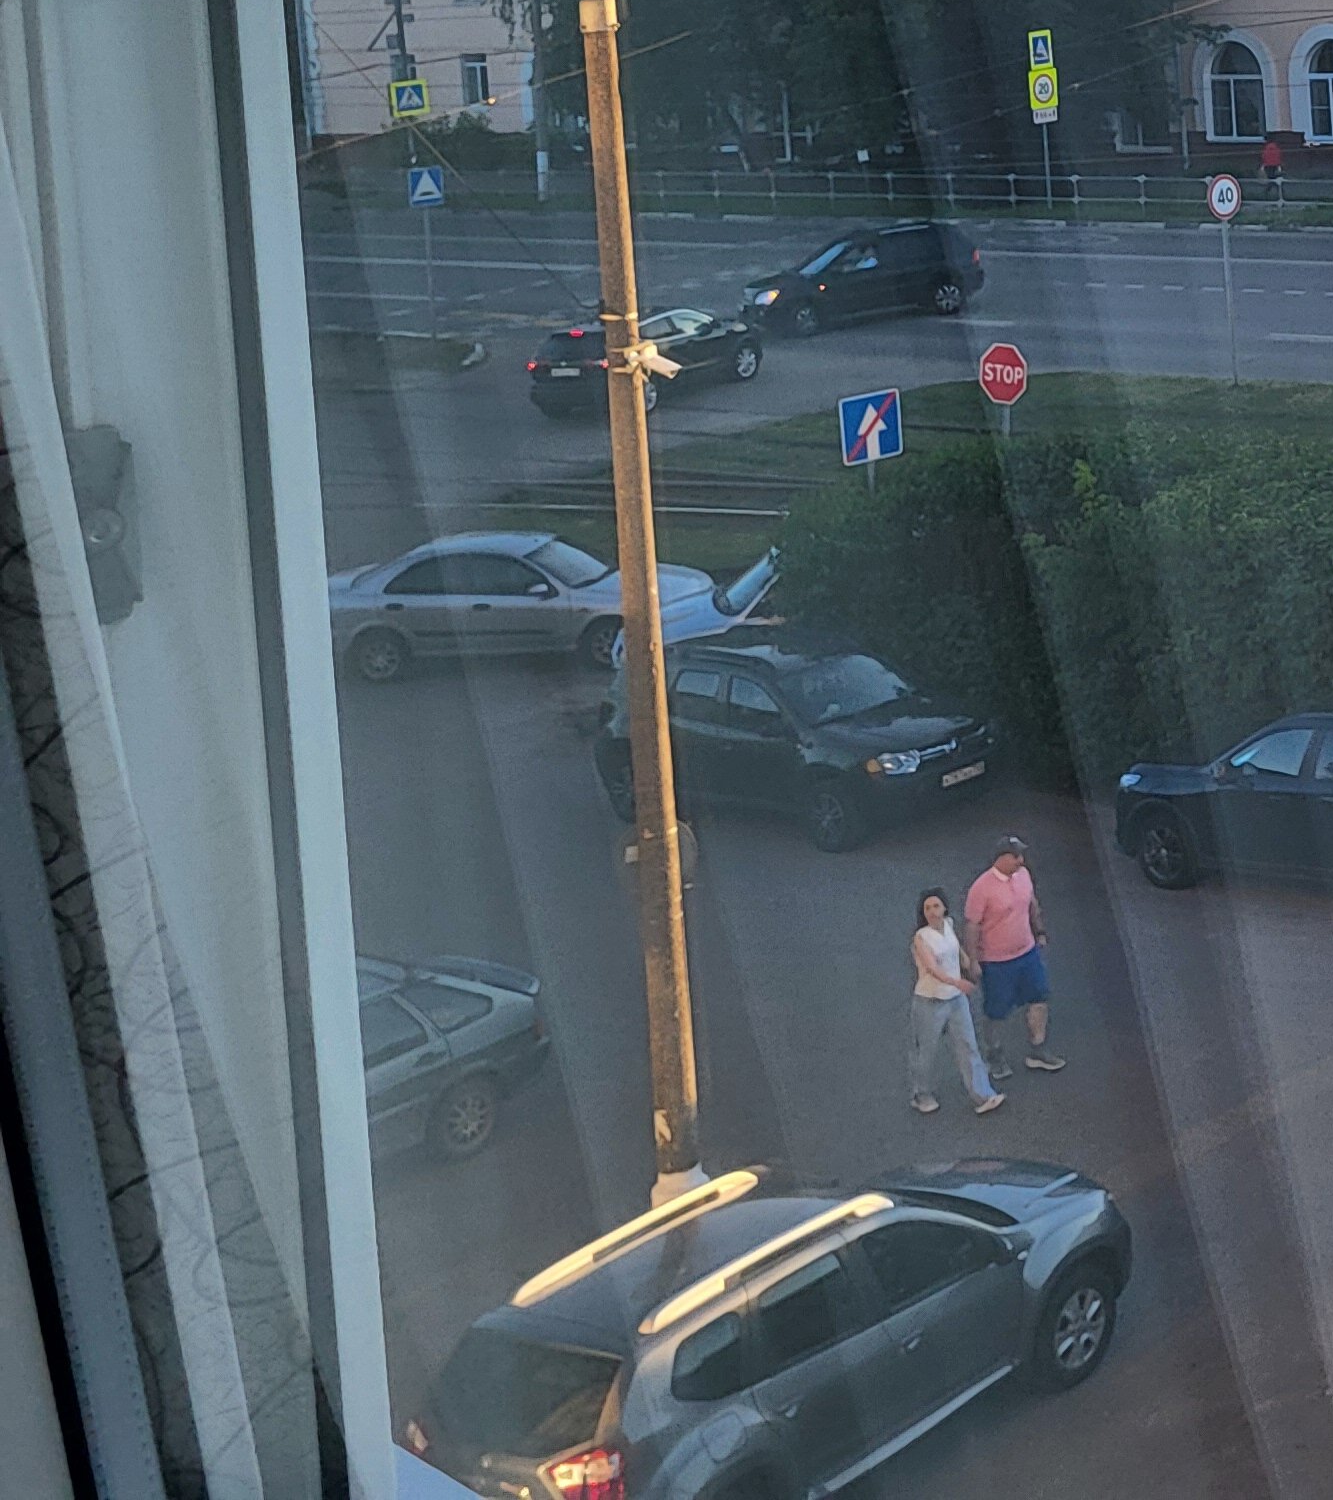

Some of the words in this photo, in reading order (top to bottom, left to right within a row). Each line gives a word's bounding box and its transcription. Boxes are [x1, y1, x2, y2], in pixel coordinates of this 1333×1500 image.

[1038, 81, 1049, 94] 20
[1218, 187, 1233, 204] 40
[984, 362, 1024, 385] STOP
